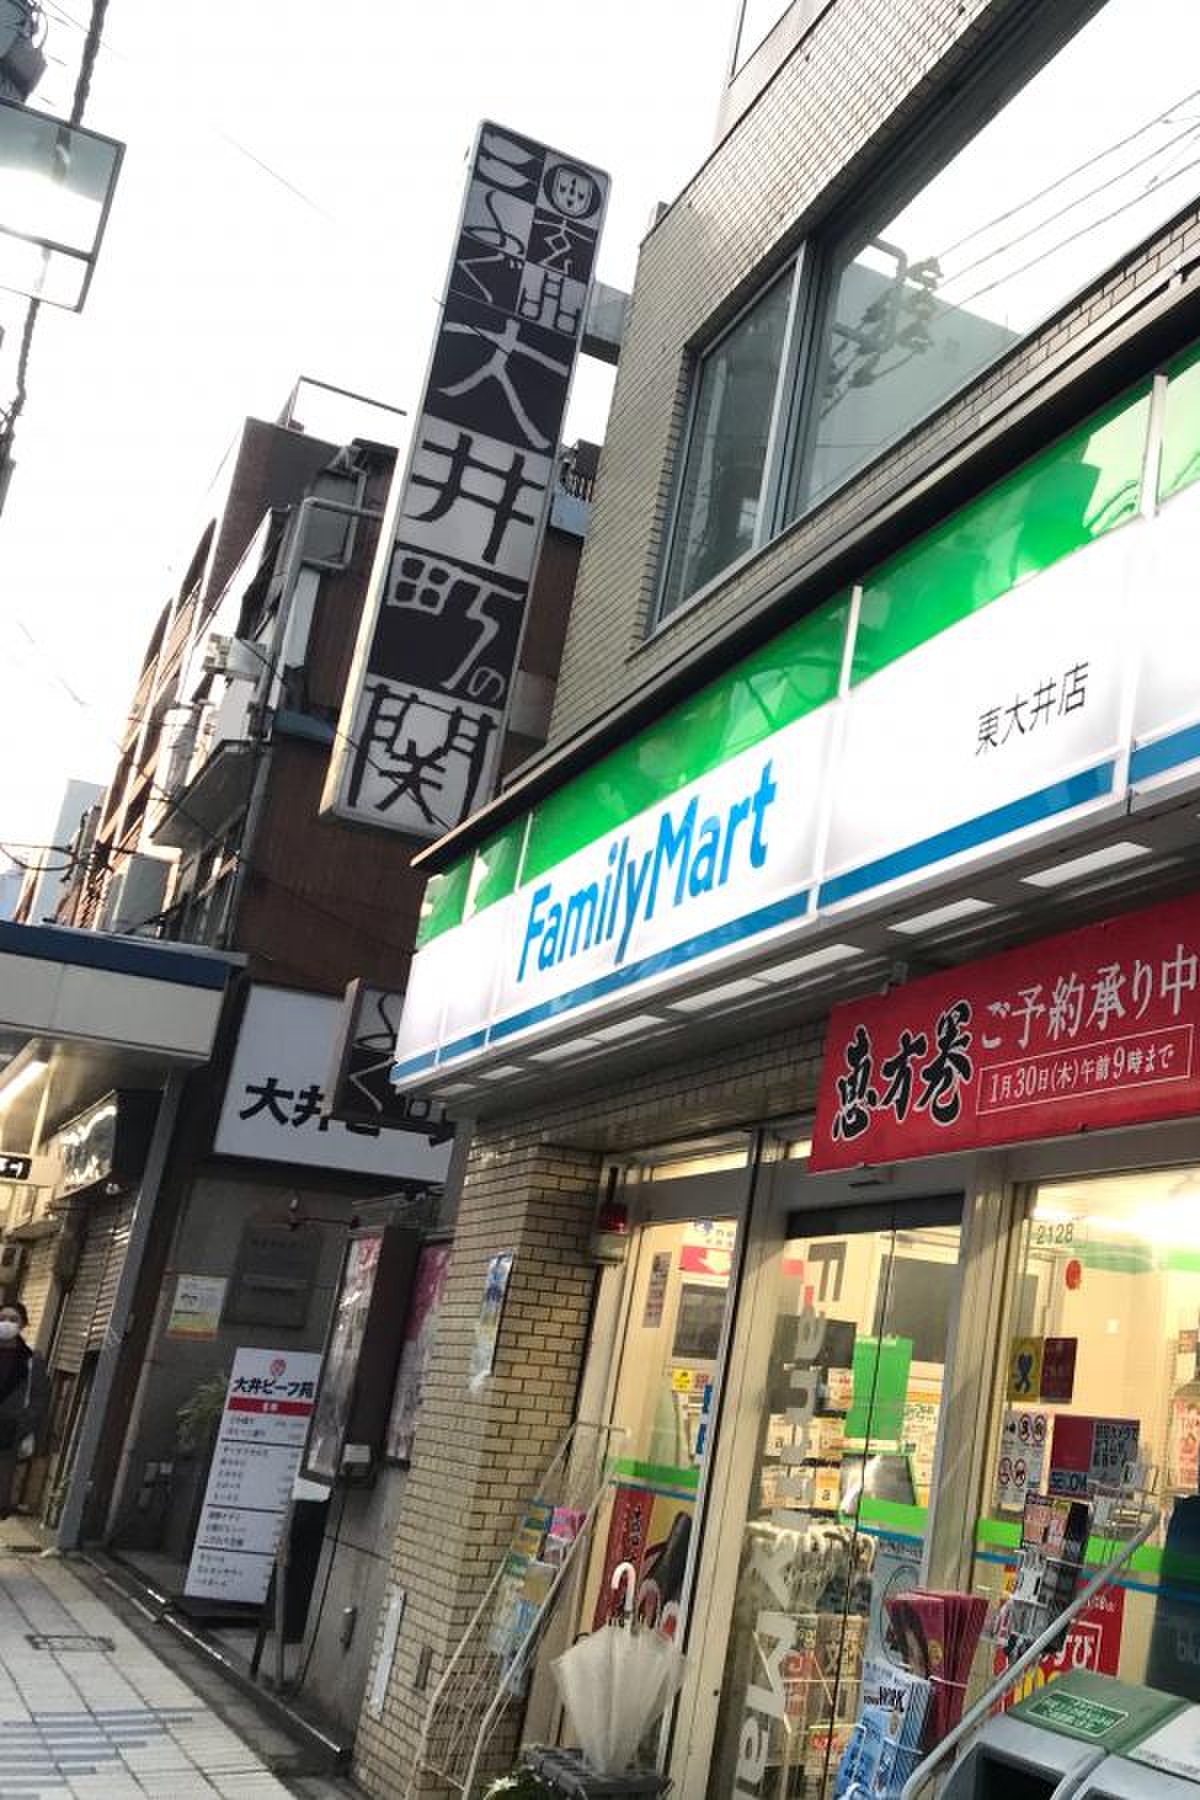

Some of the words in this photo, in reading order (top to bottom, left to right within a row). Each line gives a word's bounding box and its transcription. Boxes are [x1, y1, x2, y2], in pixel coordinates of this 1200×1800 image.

[975, 661, 1089, 757] 東大井店
[515, 758, 778, 983] FamilyMart
[980, 943, 1199, 1050] ご予約承り中
[832, 999, 974, 1142] 恵方巻
[989, 1043, 1175, 1103] 1月30日(木)午前9時まで
